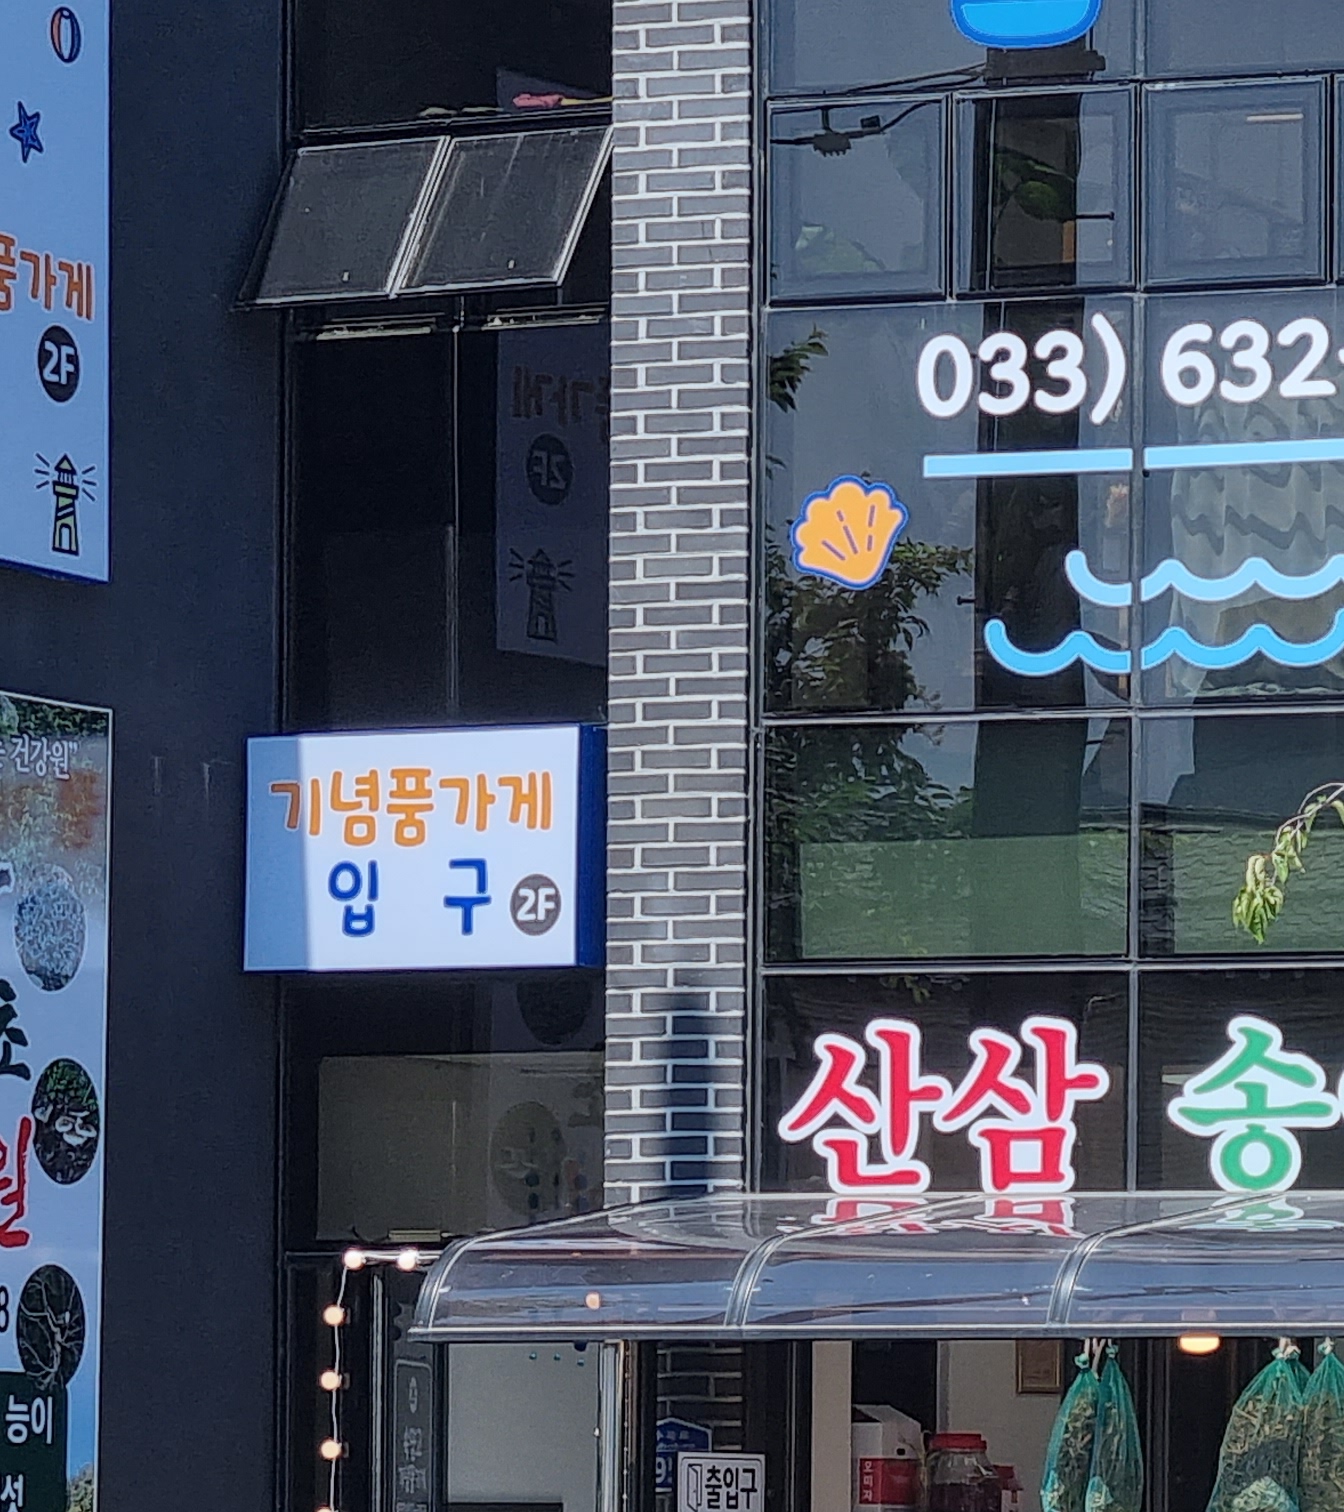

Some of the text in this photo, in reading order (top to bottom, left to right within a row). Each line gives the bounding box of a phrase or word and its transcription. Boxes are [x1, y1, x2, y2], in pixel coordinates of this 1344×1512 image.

[42, 341, 75, 385] 2F
[916, 313, 1128, 425] 033)
[269, 767, 553, 847] 기념품가게
[517, 888, 555, 921] 2F
[778, 1015, 1109, 1193] 산삼
[5, 1394, 53, 1445] 능이
[705, 1465, 758, 1511] 출입구
